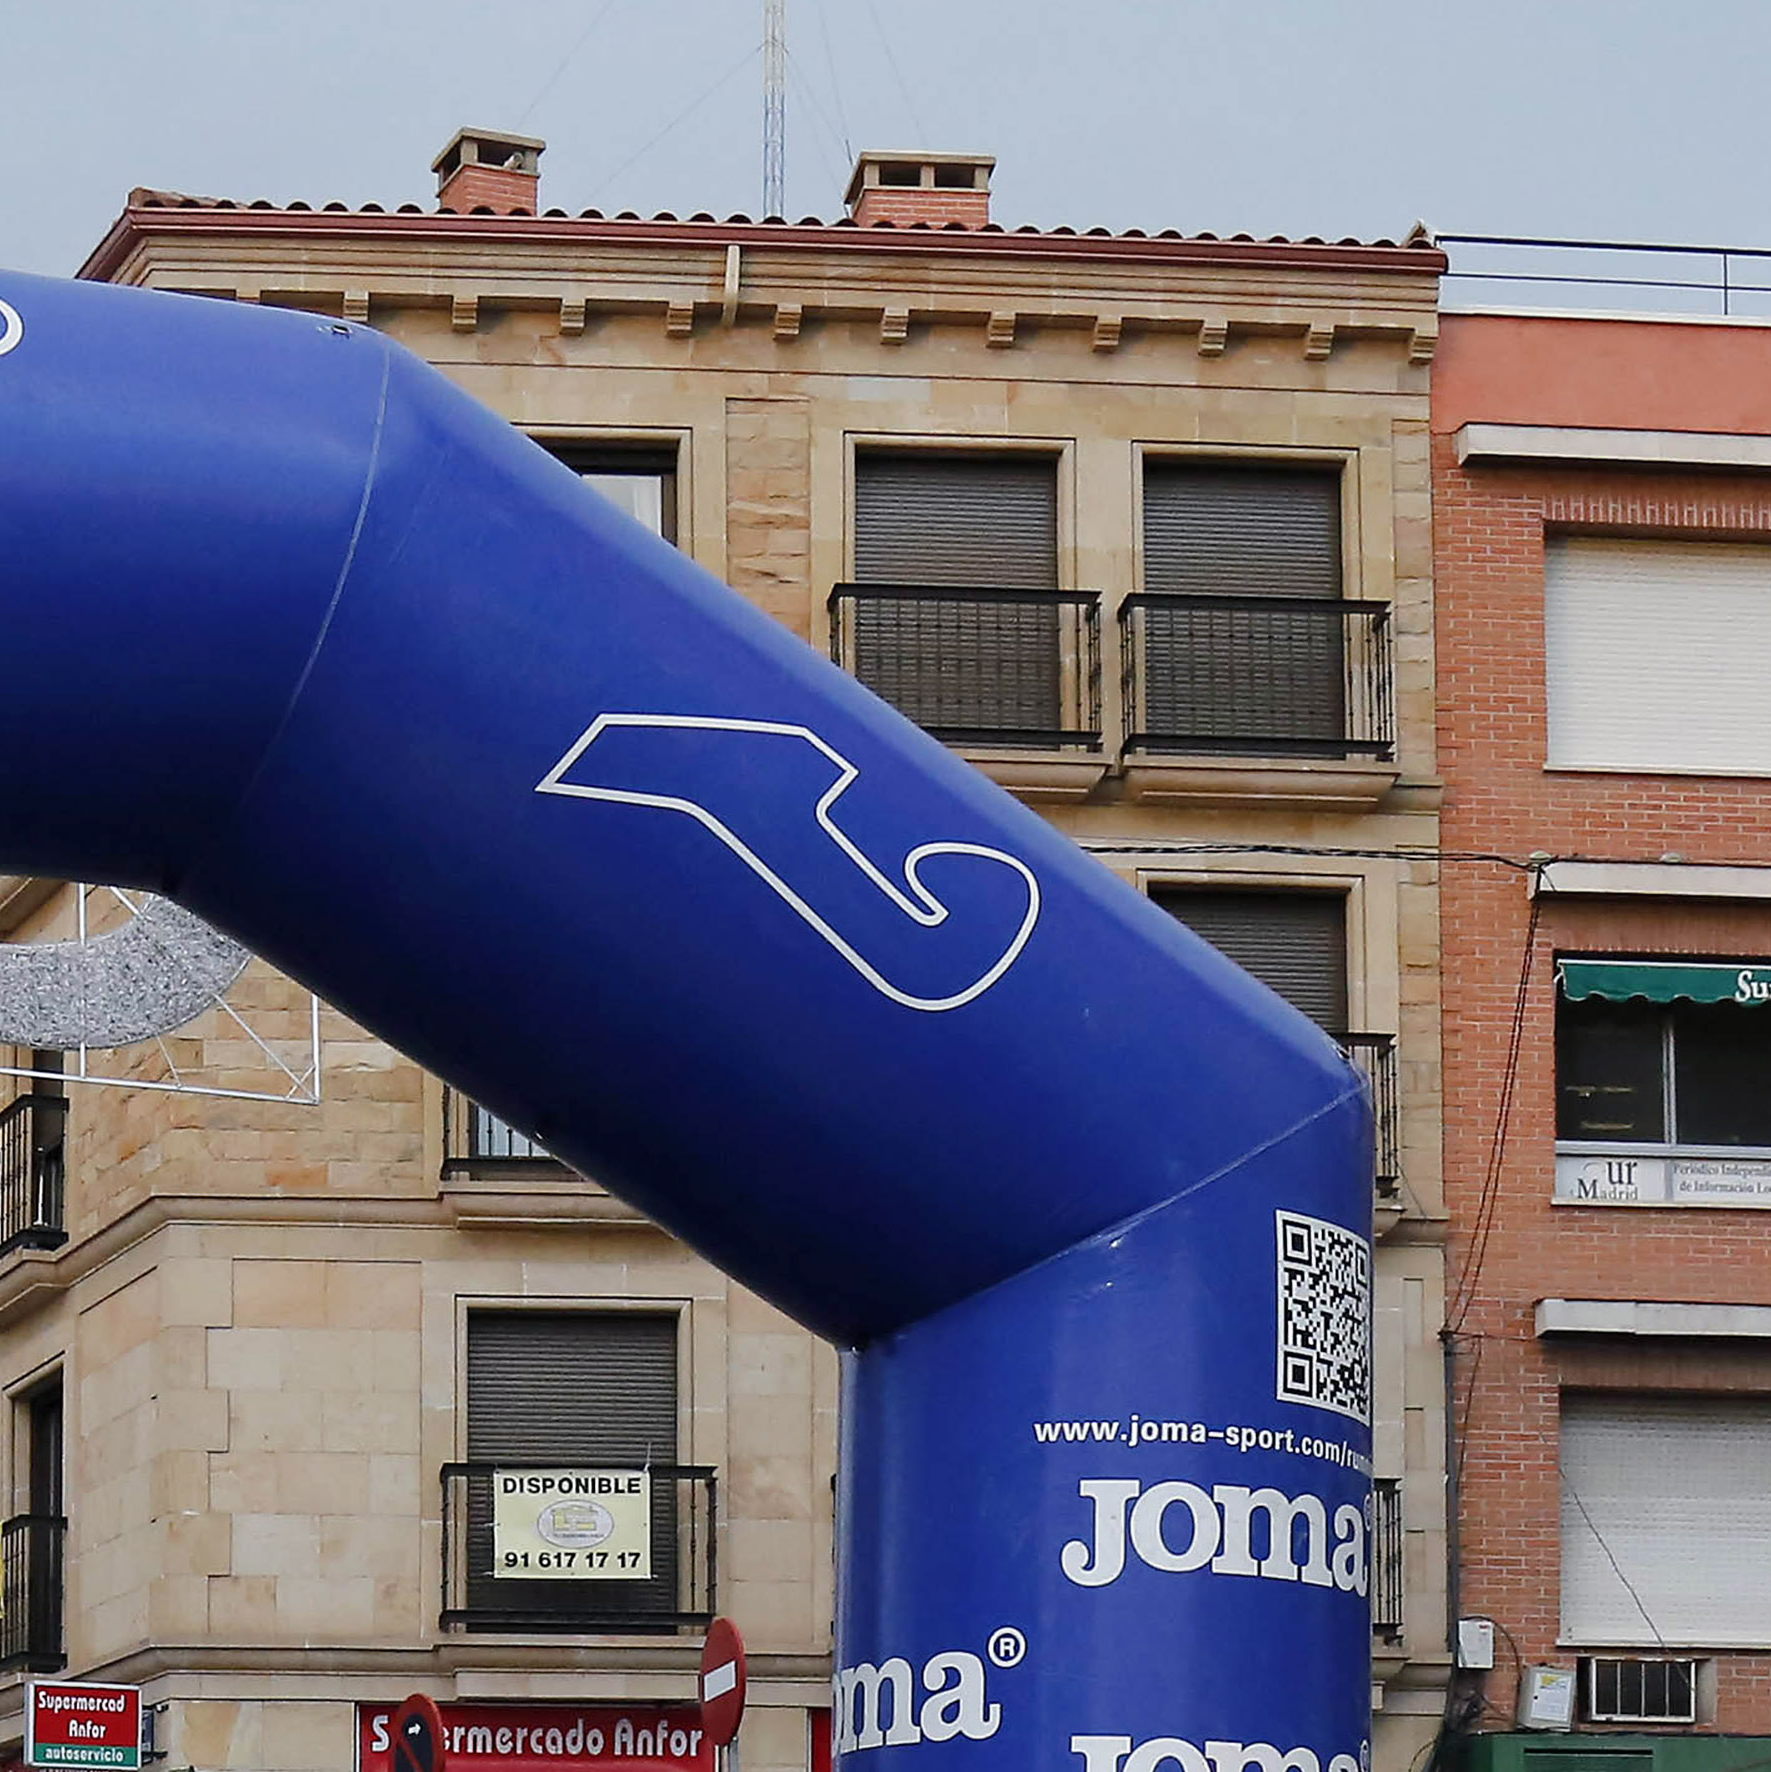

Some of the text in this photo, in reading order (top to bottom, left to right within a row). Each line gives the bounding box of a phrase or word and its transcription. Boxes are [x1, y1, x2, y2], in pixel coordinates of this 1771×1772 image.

[502, 1476, 641, 1496] DISPONIBLE
[504, 1551, 641, 1569] 91 617 17 17
[69, 1719, 106, 1739] Anfor
[614, 1718, 703, 1757] Anfor
[45, 1746, 124, 1762] autoservicio
